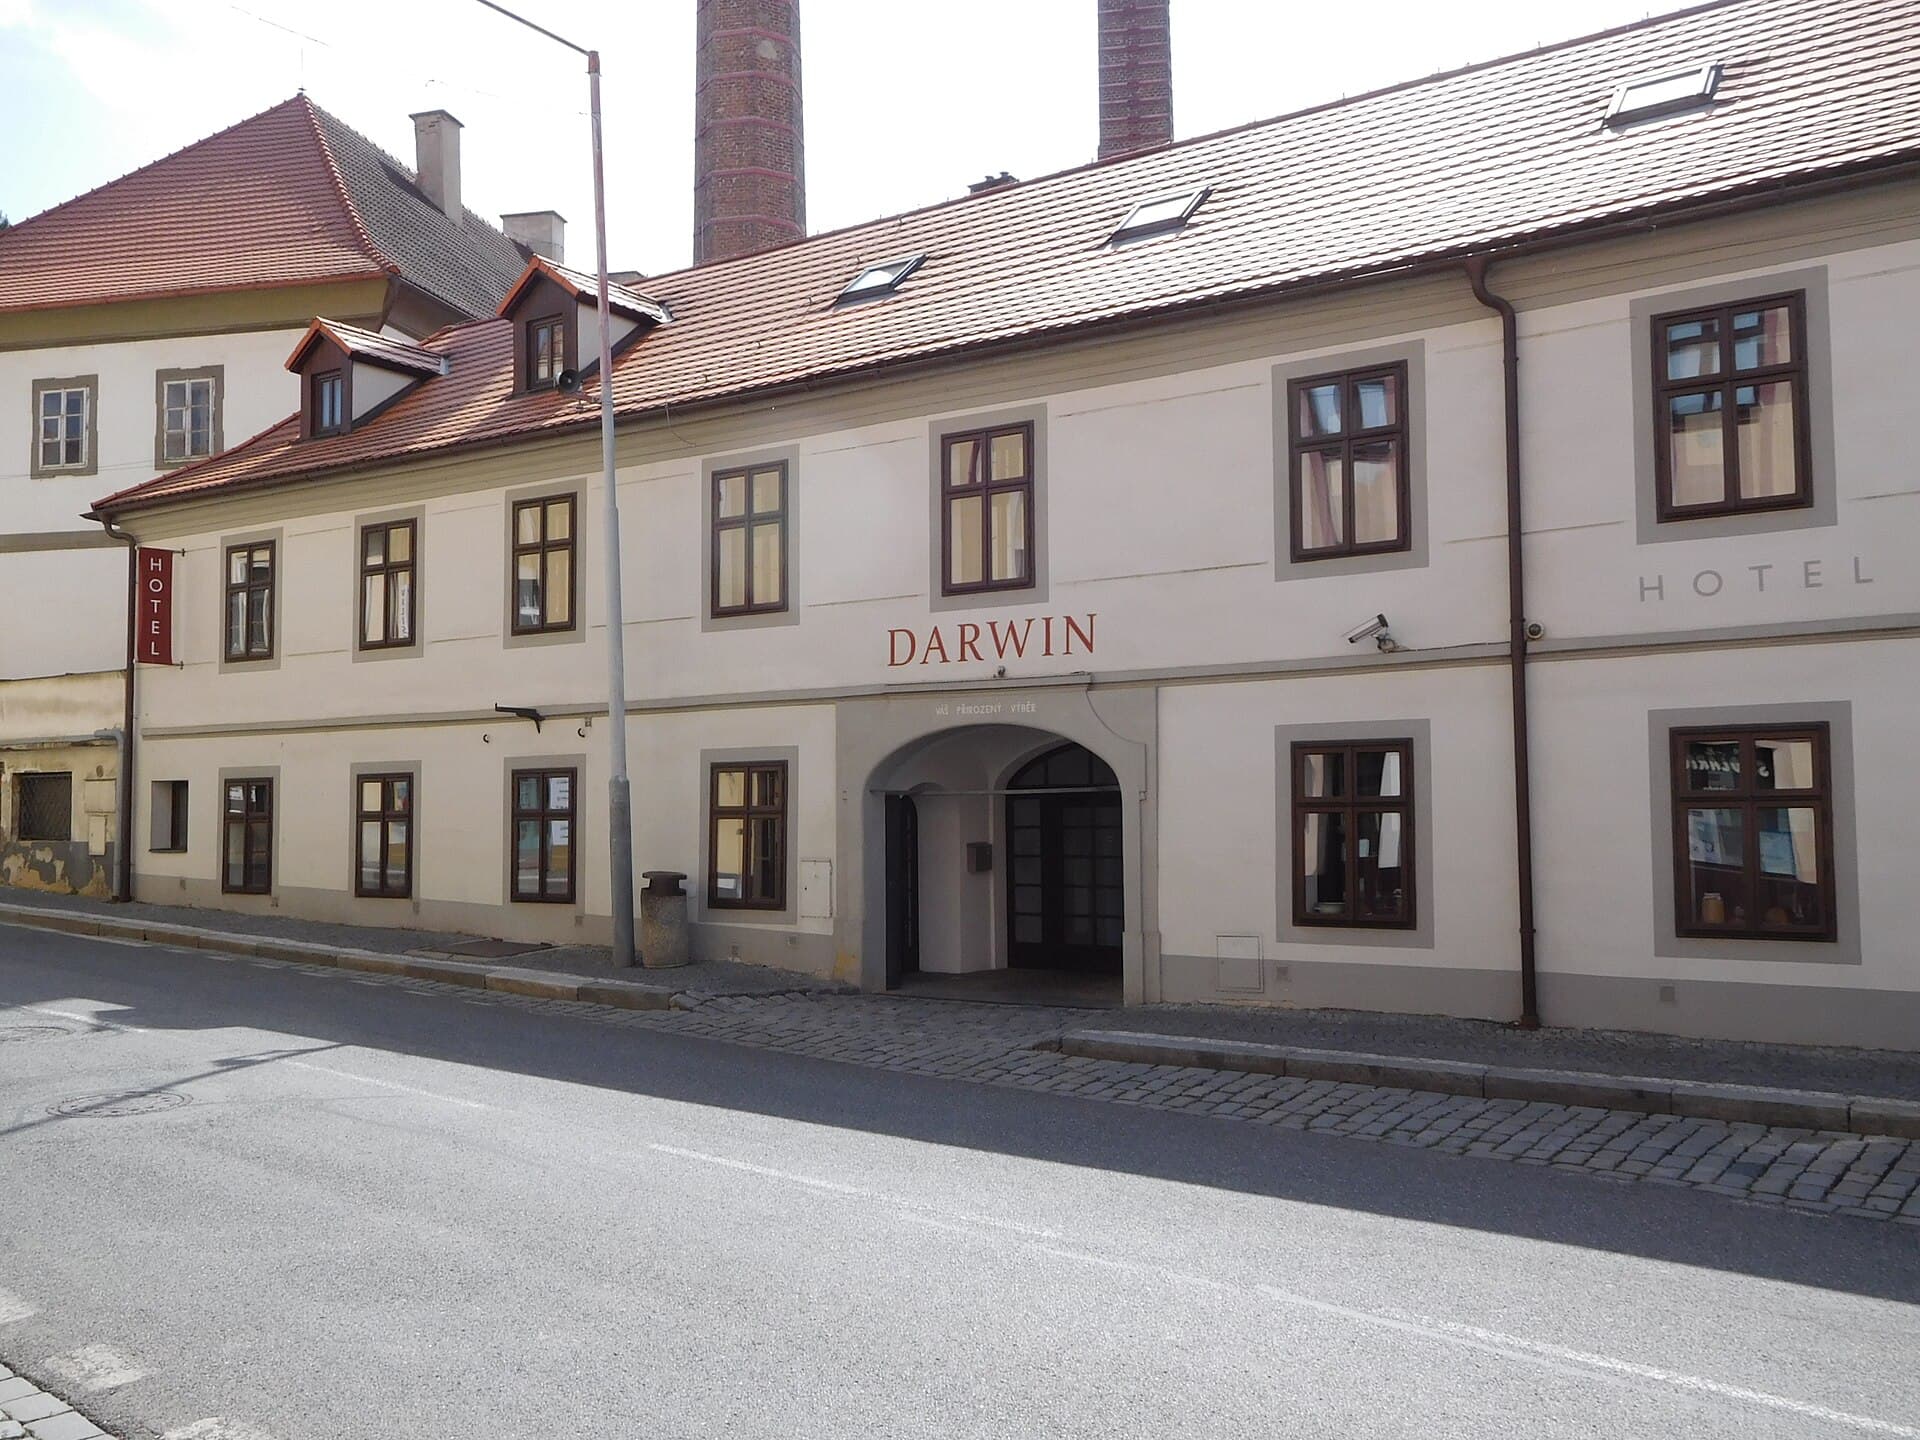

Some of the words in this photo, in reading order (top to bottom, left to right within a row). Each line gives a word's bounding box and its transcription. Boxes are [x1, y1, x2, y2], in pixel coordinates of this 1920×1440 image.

[1638, 556, 1874, 602] HOTEL
[148, 557, 164, 656] HOTEL
[887, 613, 1097, 667] DARWIN
